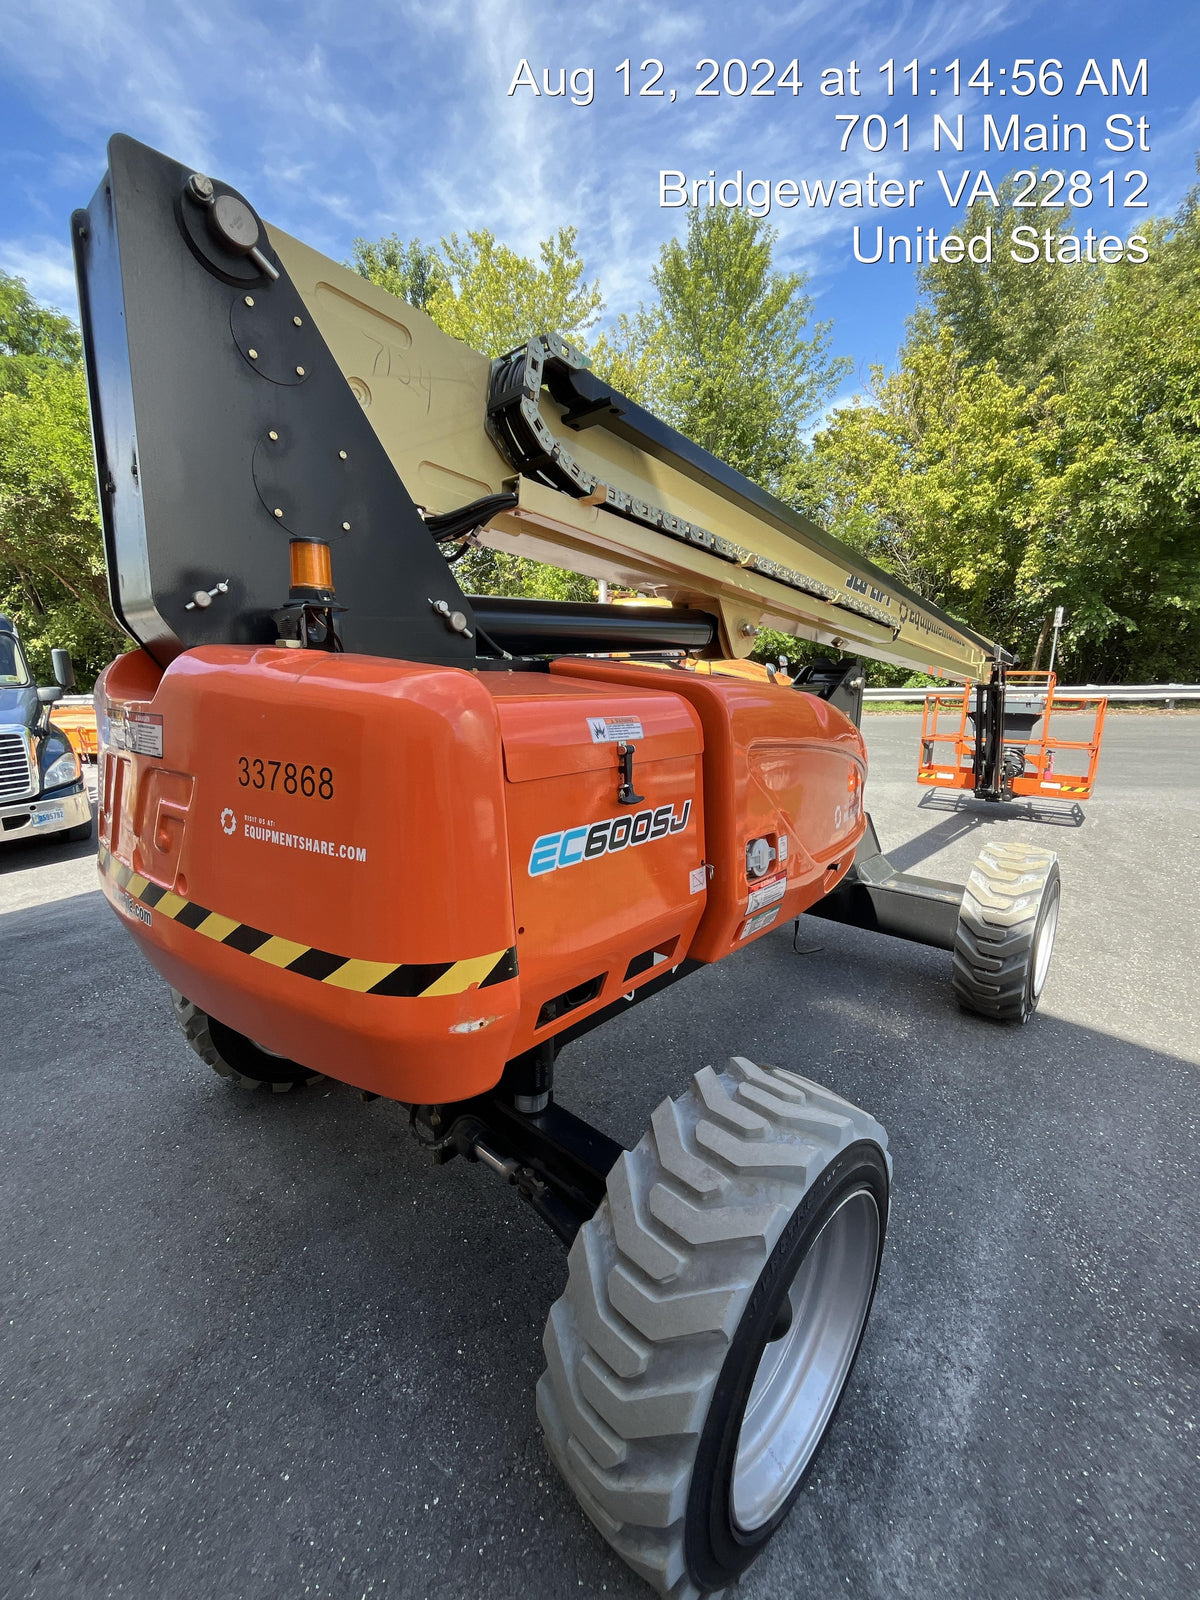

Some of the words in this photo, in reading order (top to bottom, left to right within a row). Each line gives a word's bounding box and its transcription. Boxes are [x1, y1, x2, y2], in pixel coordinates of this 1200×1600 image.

[238, 756, 334, 800] 337868
[244, 824, 367, 862] EQUIPMENTSHARE.COM
[529, 801, 692, 876] EC600SJ
